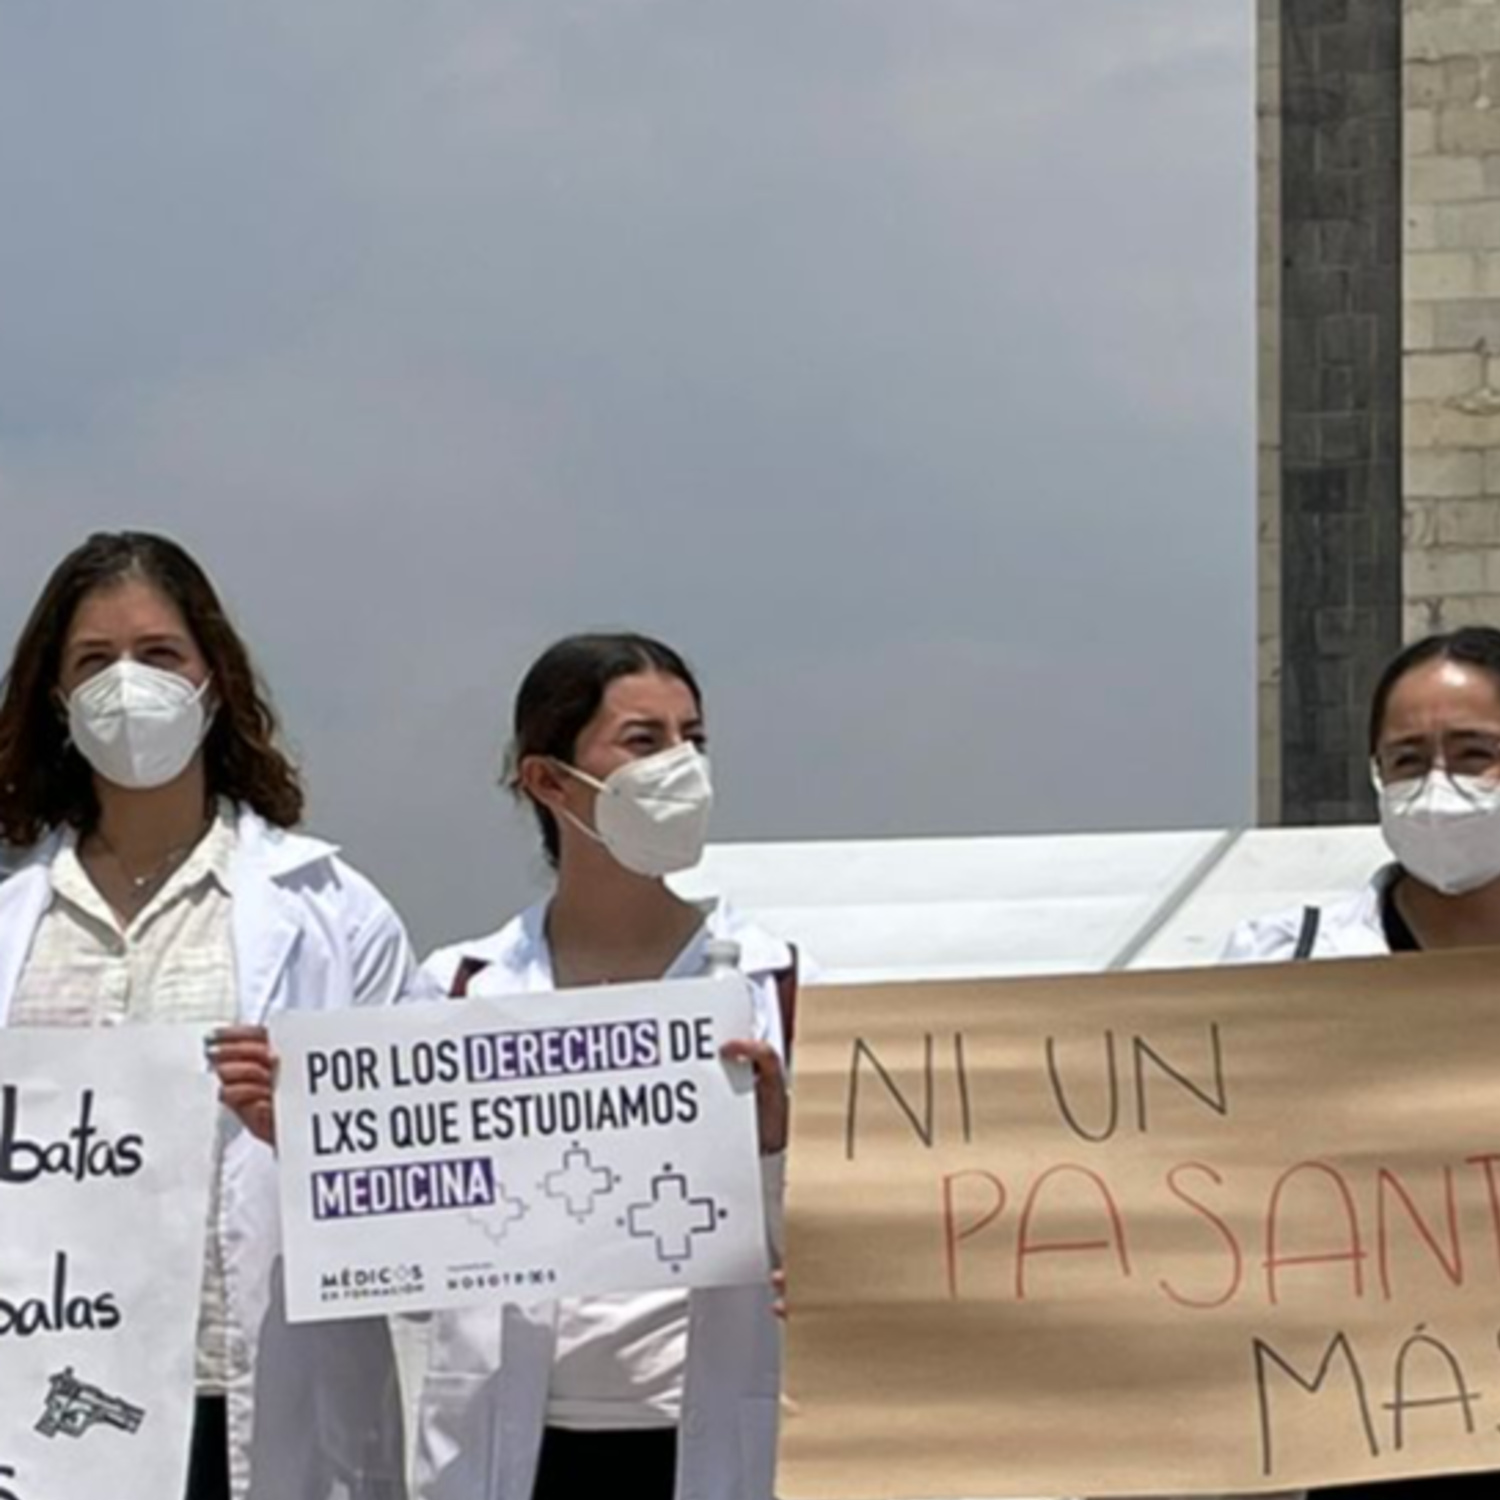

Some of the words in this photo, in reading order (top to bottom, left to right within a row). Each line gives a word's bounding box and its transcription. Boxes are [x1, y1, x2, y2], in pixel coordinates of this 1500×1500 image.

[307, 1047, 380, 1095] POR
[390, 1038, 459, 1088] LOS
[468, 1021, 659, 1080] DERECHOS
[669, 1017, 715, 1063] DE
[846, 1030, 973, 1161] NI
[1046, 1020, 1228, 1144] UN
[0, 1084, 144, 1183] batas
[312, 1107, 379, 1156] LXS
[389, 1100, 460, 1149] QUE
[471, 1080, 700, 1142] ESTUDIAMOS
[315, 1159, 493, 1217] MEDICINA
